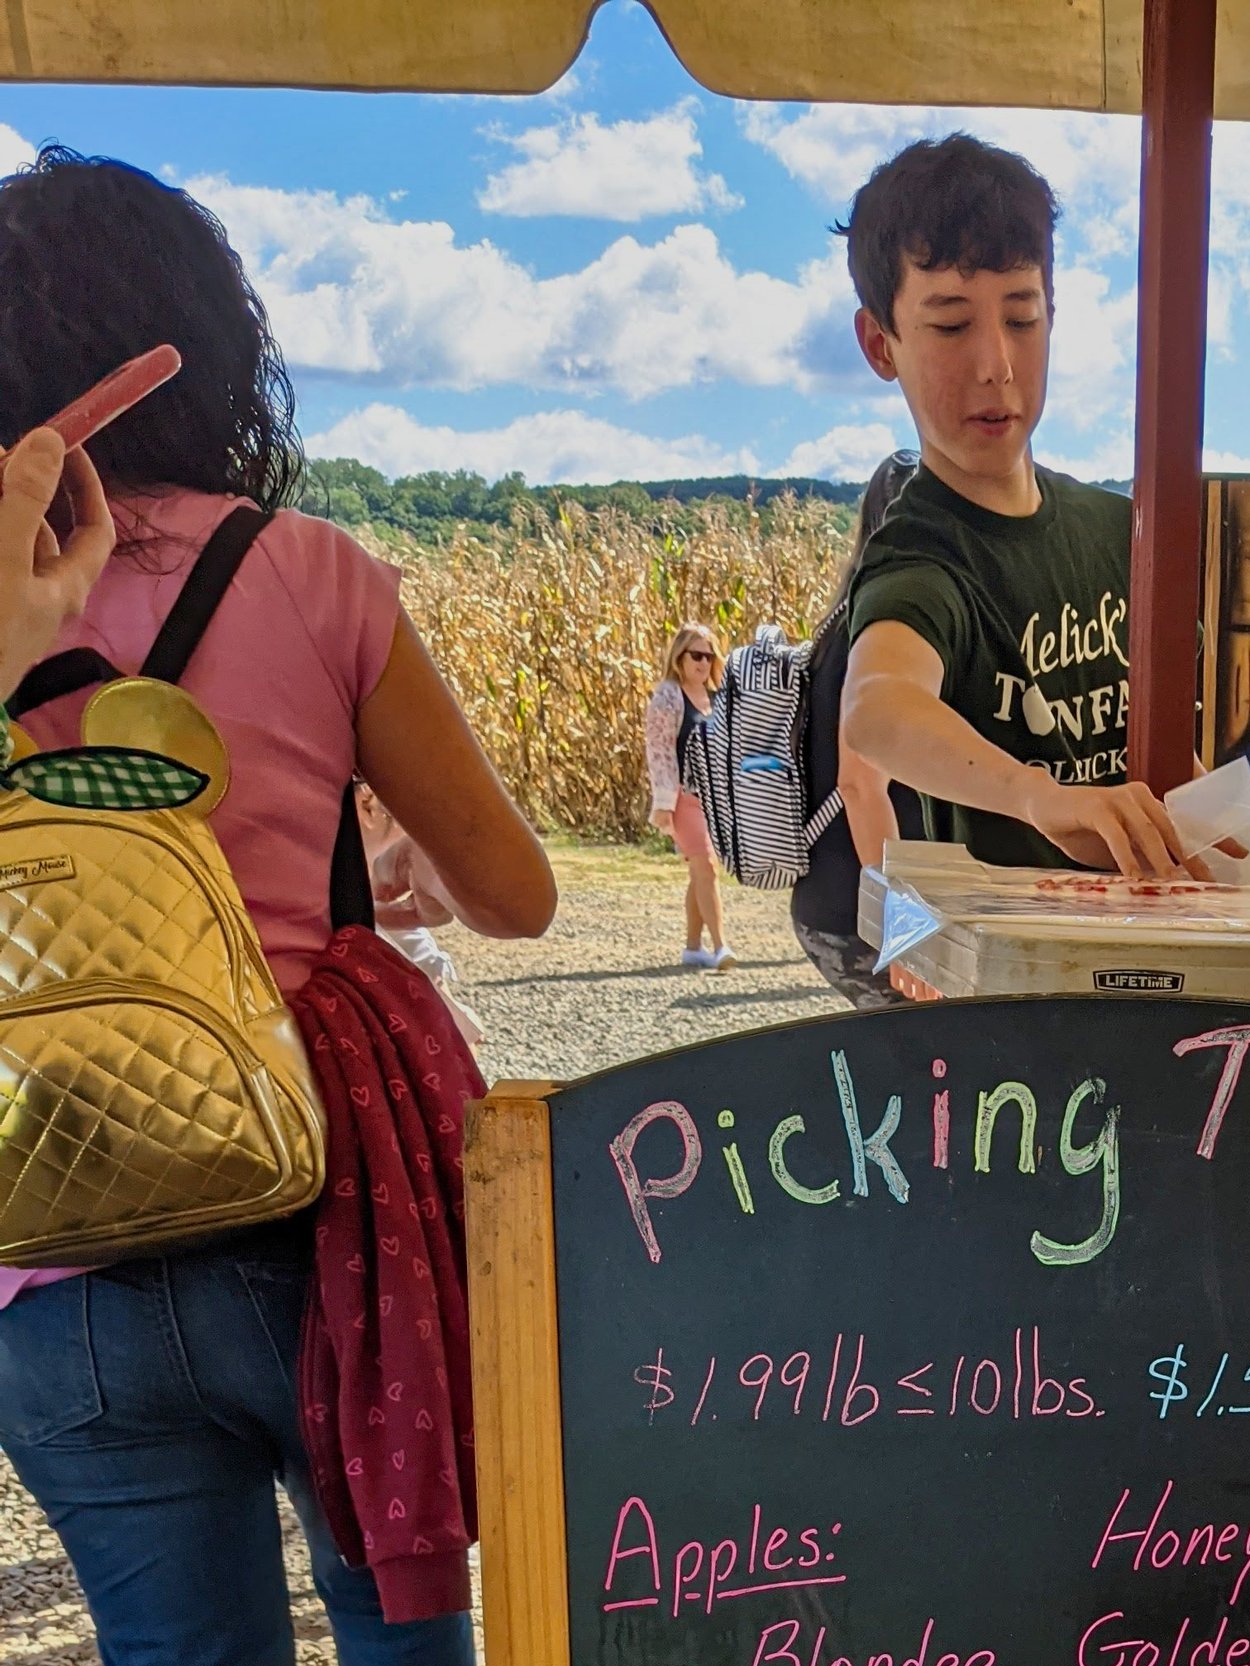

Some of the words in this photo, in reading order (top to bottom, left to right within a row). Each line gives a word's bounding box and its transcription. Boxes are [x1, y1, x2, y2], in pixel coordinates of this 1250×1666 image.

[31, 860, 66, 877] Mouse
[1105, 974, 1173, 988] LIFETIME
[609, 1048, 1120, 1264] Picking
[604, 1497, 846, 1617] Apples:
